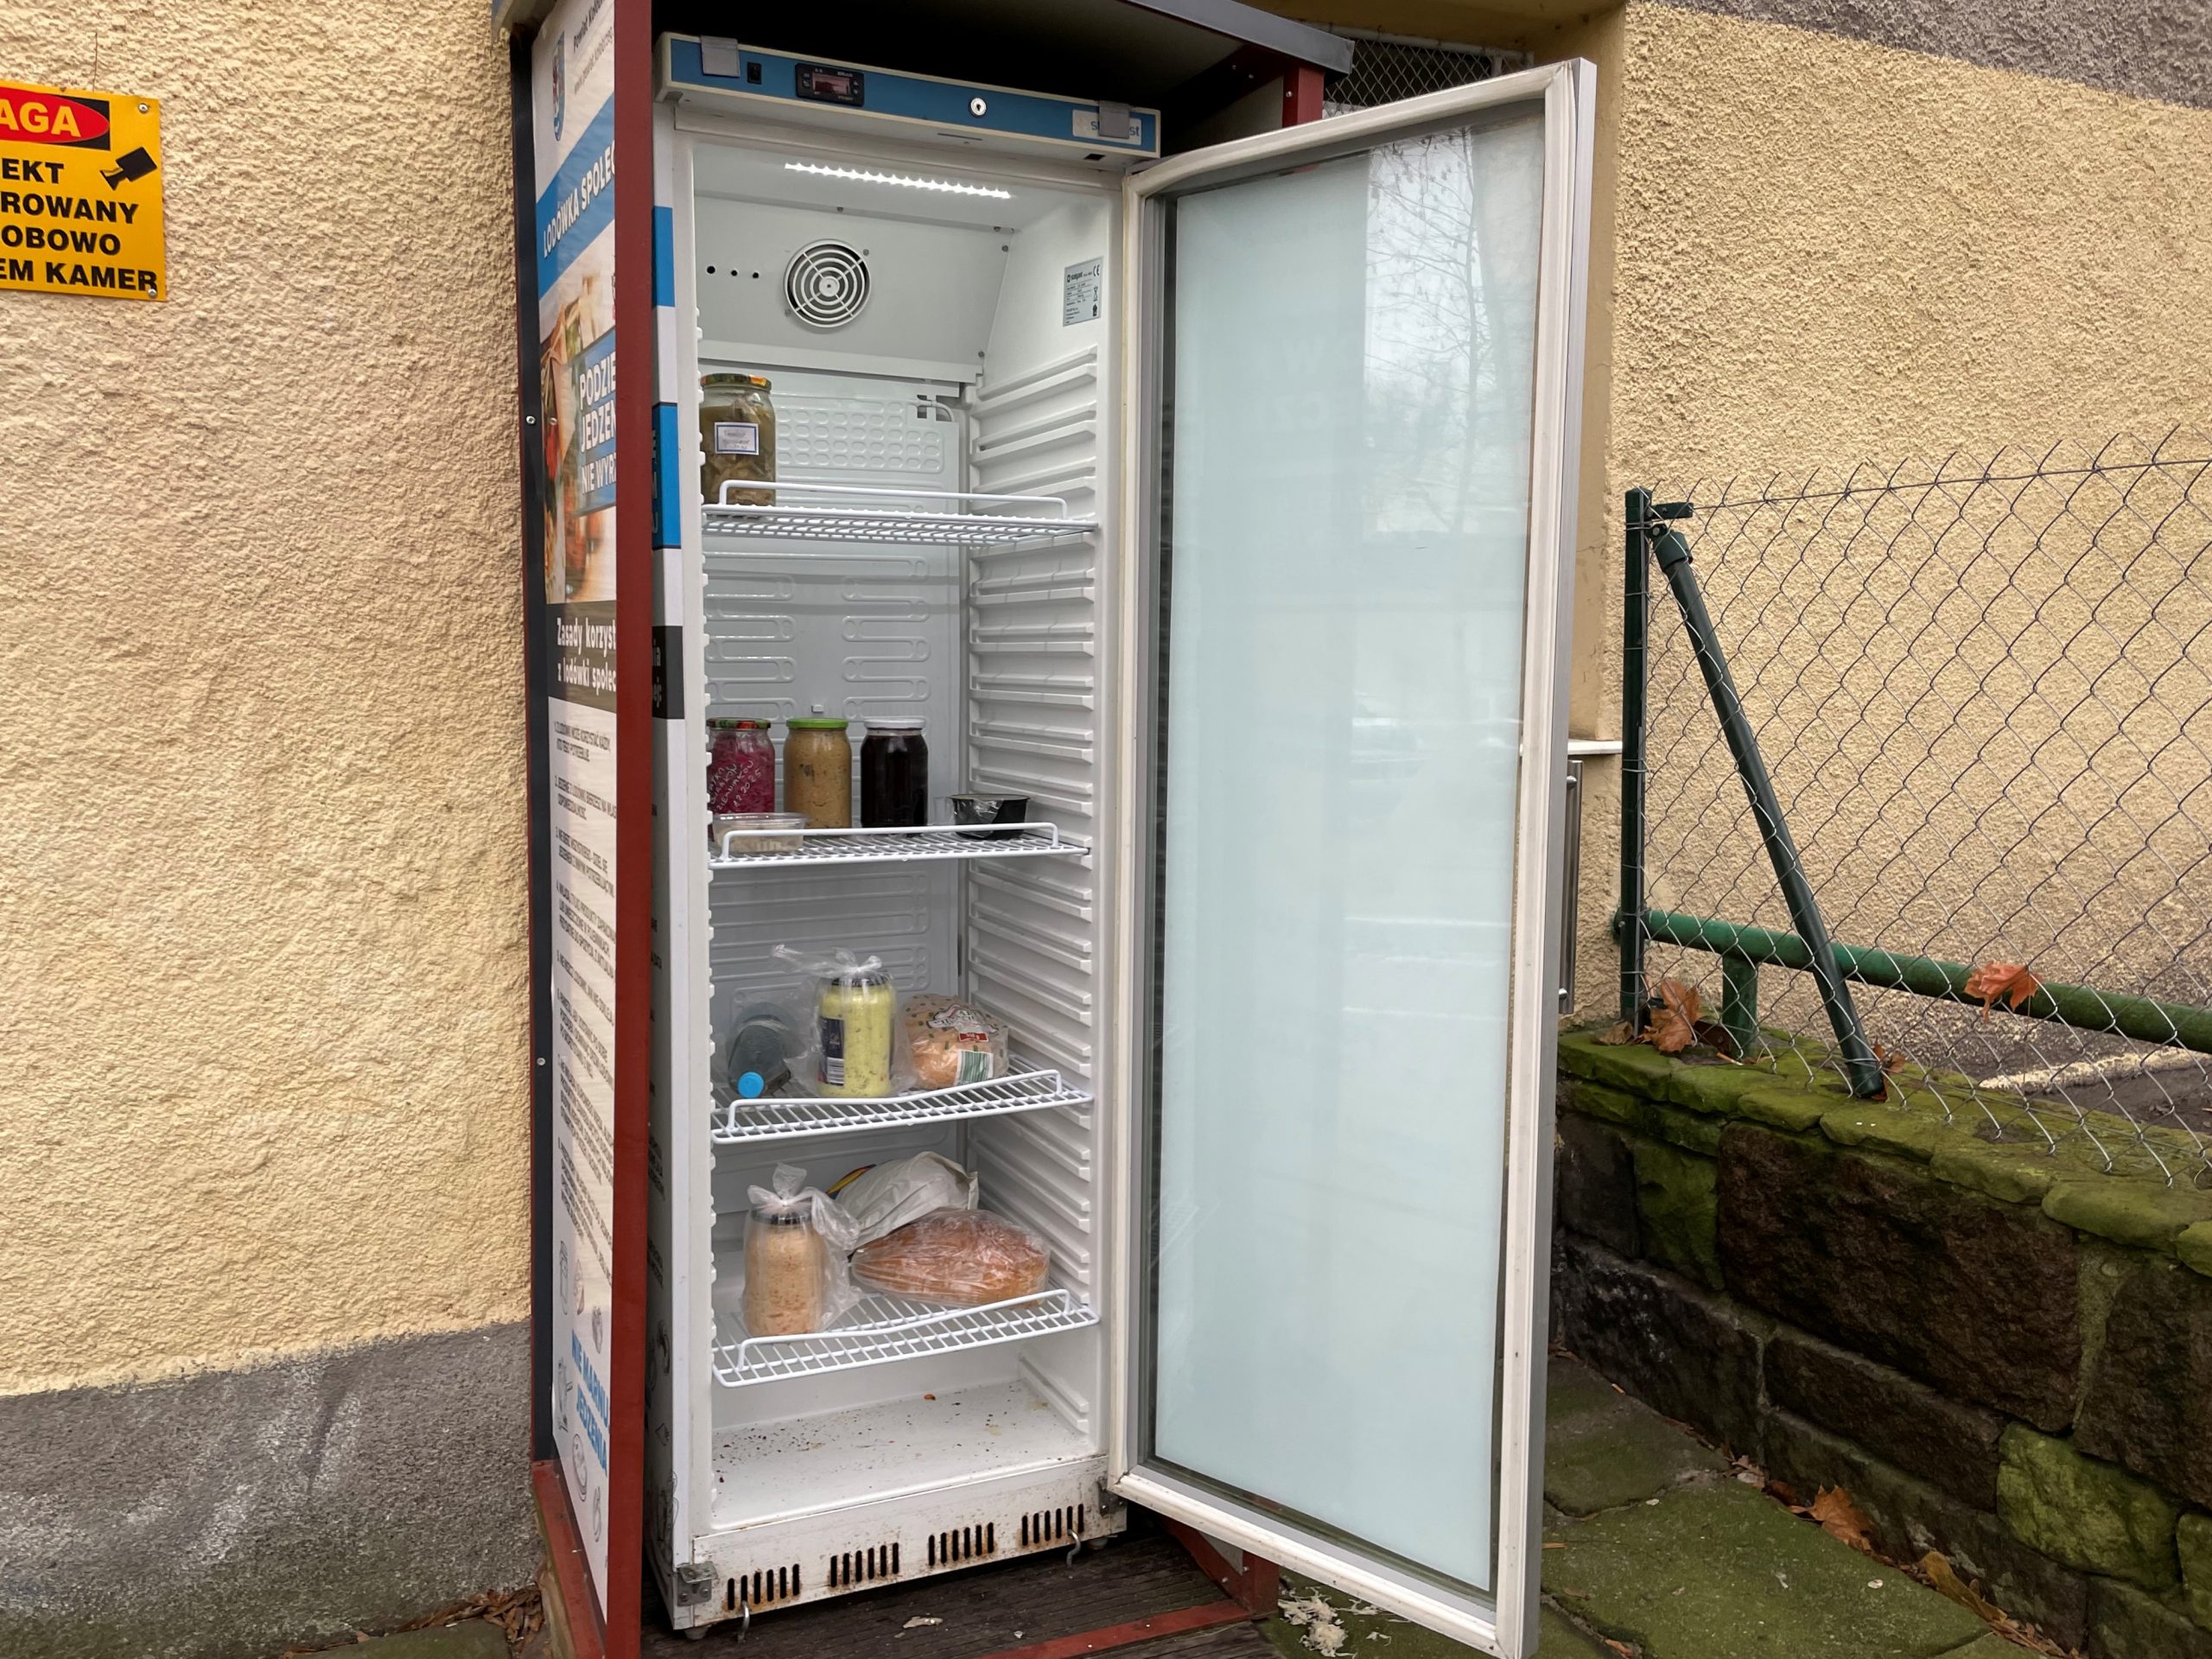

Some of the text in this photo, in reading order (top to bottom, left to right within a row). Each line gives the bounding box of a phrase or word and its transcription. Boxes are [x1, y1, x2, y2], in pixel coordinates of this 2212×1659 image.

[2, 157, 65, 184] EKT
[1, 191, 139, 225] ROWANY
[1, 225, 121, 256] OBOWO
[46, 261, 158, 292] KAMER
[582, 462, 595, 494] NIE
[557, 617, 583, 655] Zasady
[563, 657, 590, 687] lodówki
